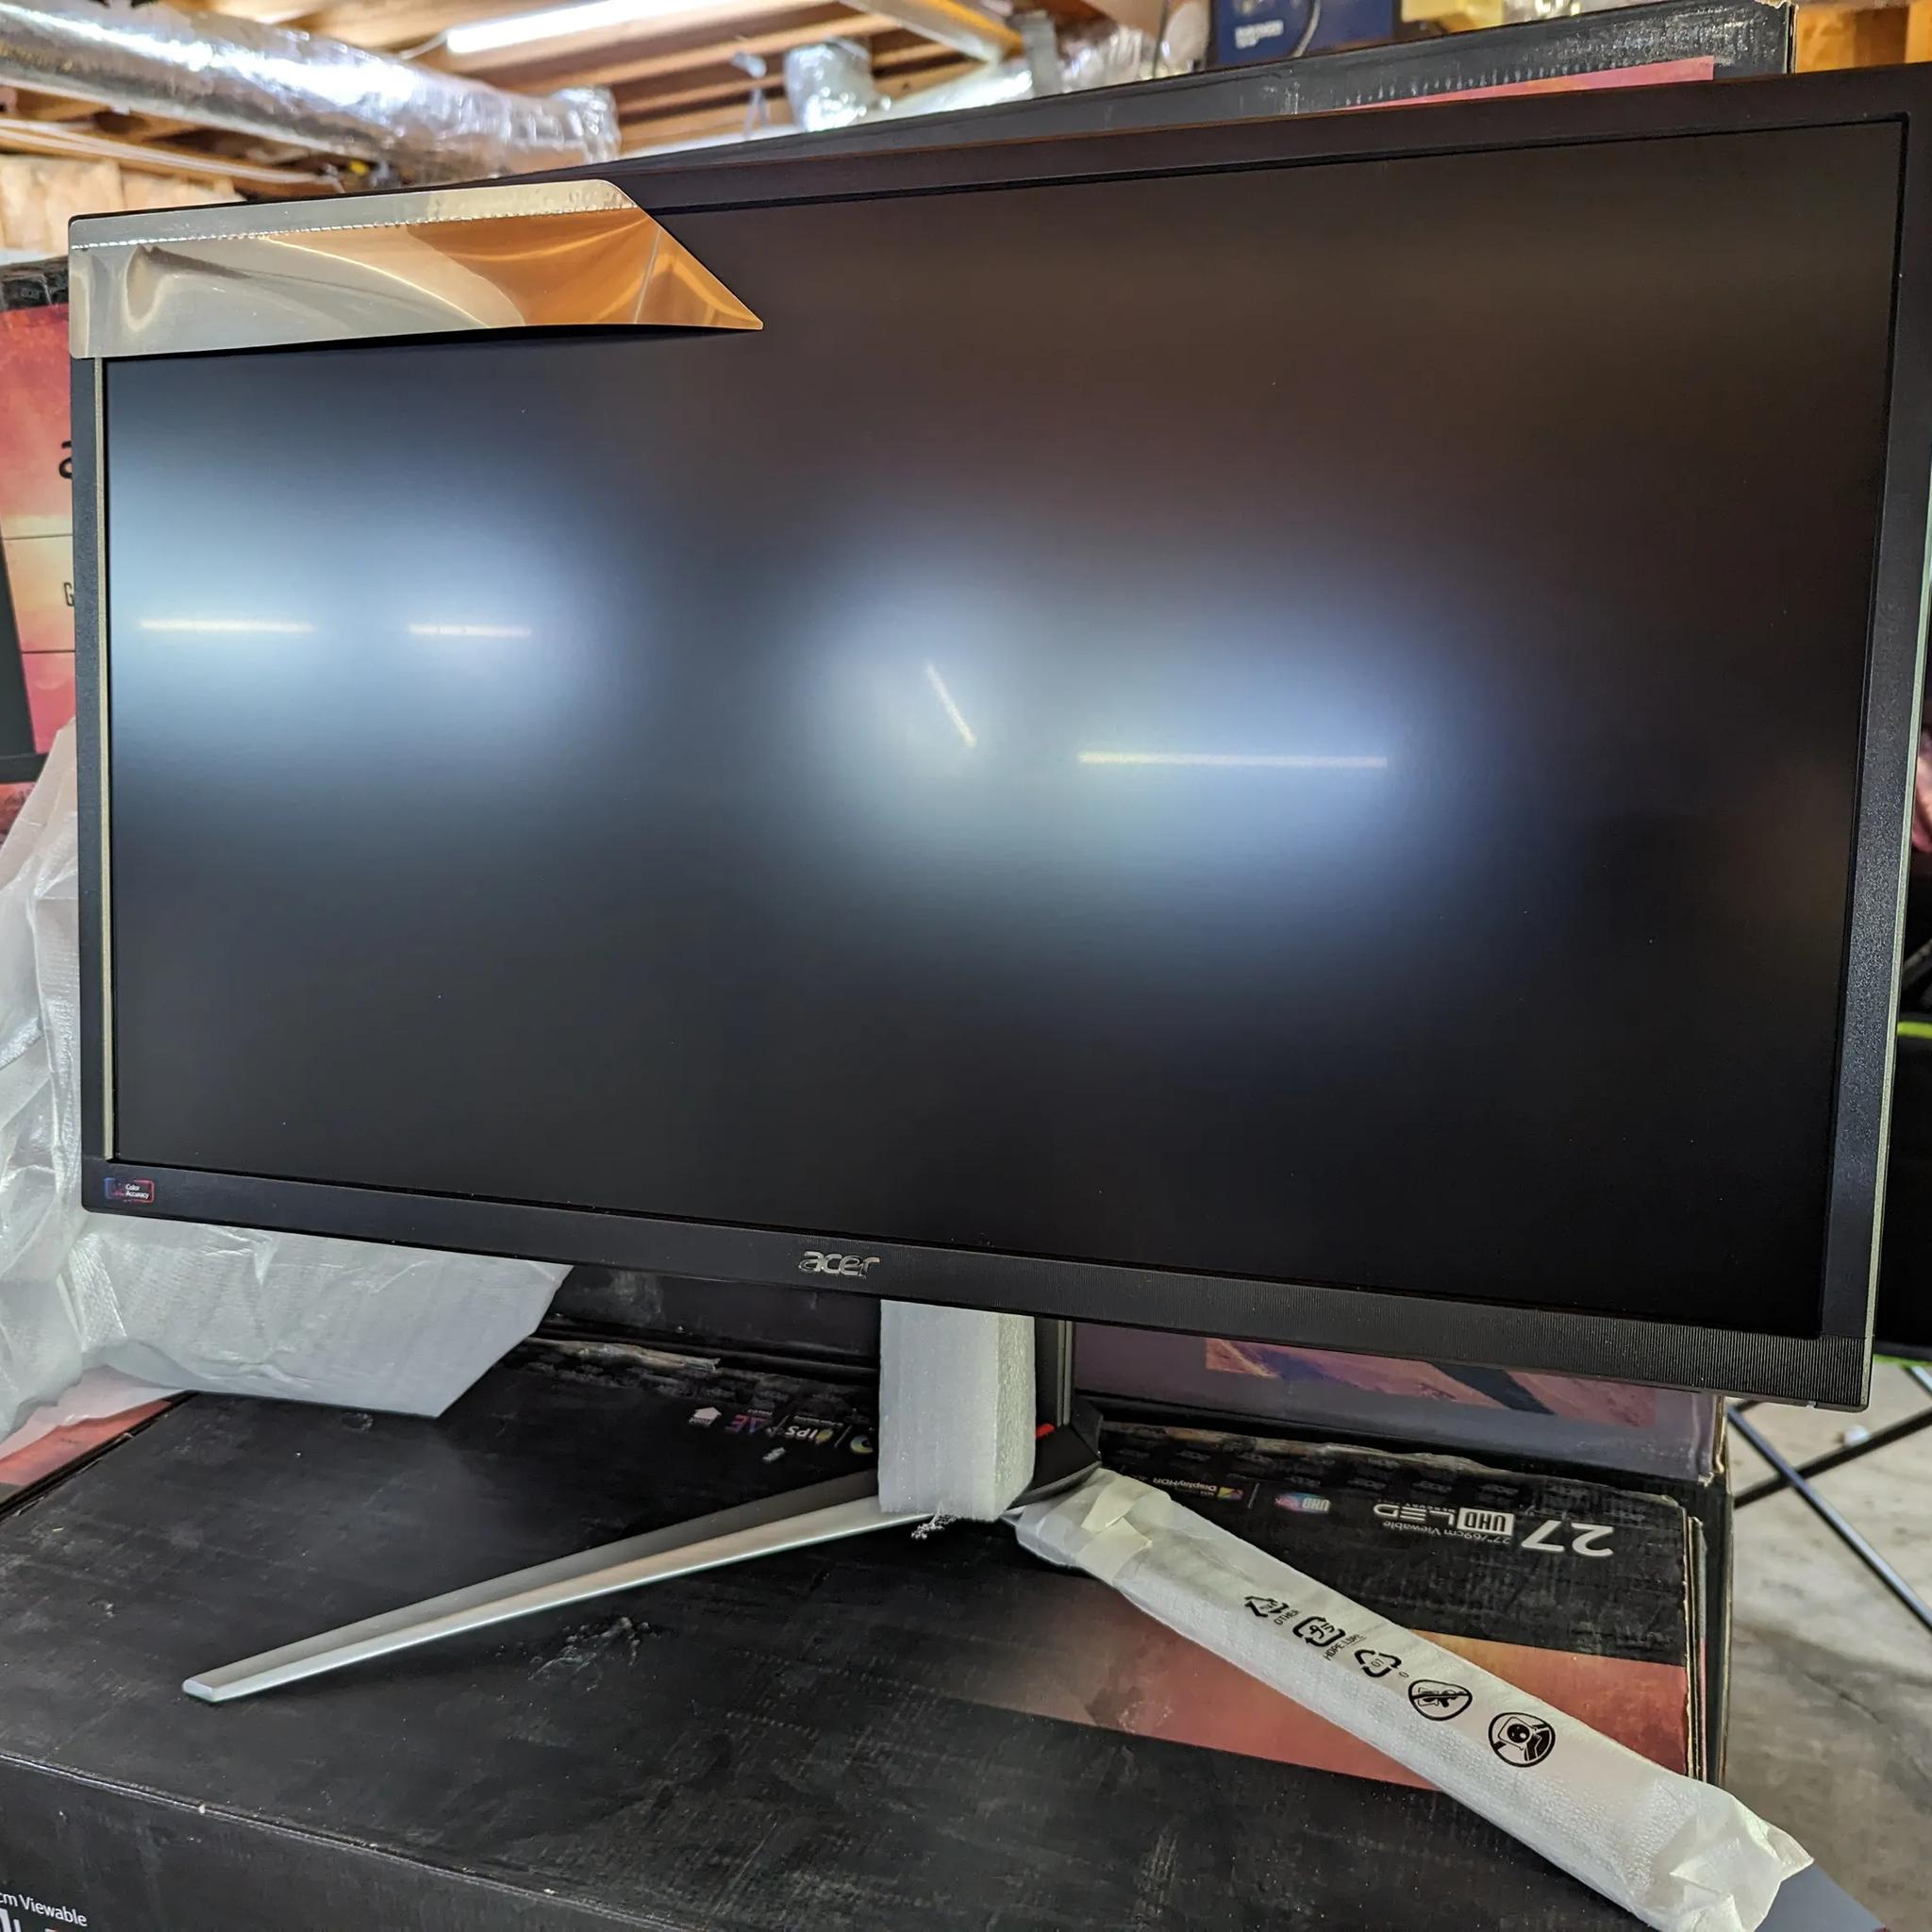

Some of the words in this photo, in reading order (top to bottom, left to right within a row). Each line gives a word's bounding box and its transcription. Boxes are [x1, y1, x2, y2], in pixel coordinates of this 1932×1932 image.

[125, 1191, 149, 1199] Accuracy
[798, 1251, 880, 1278] acer
[785, 1425, 818, 1441] IPS
[1153, 1477, 1217, 1491] DisplayHDR
[1302, 1497, 1331, 1512] UHD
[1374, 1503, 1456, 1525] LED
[1383, 1520, 1441, 1536] Viewable
[1462, 1510, 1508, 1533] UHD
[1521, 1520, 1614, 1557] 27
[18, 1894, 88, 1926] Viewable
